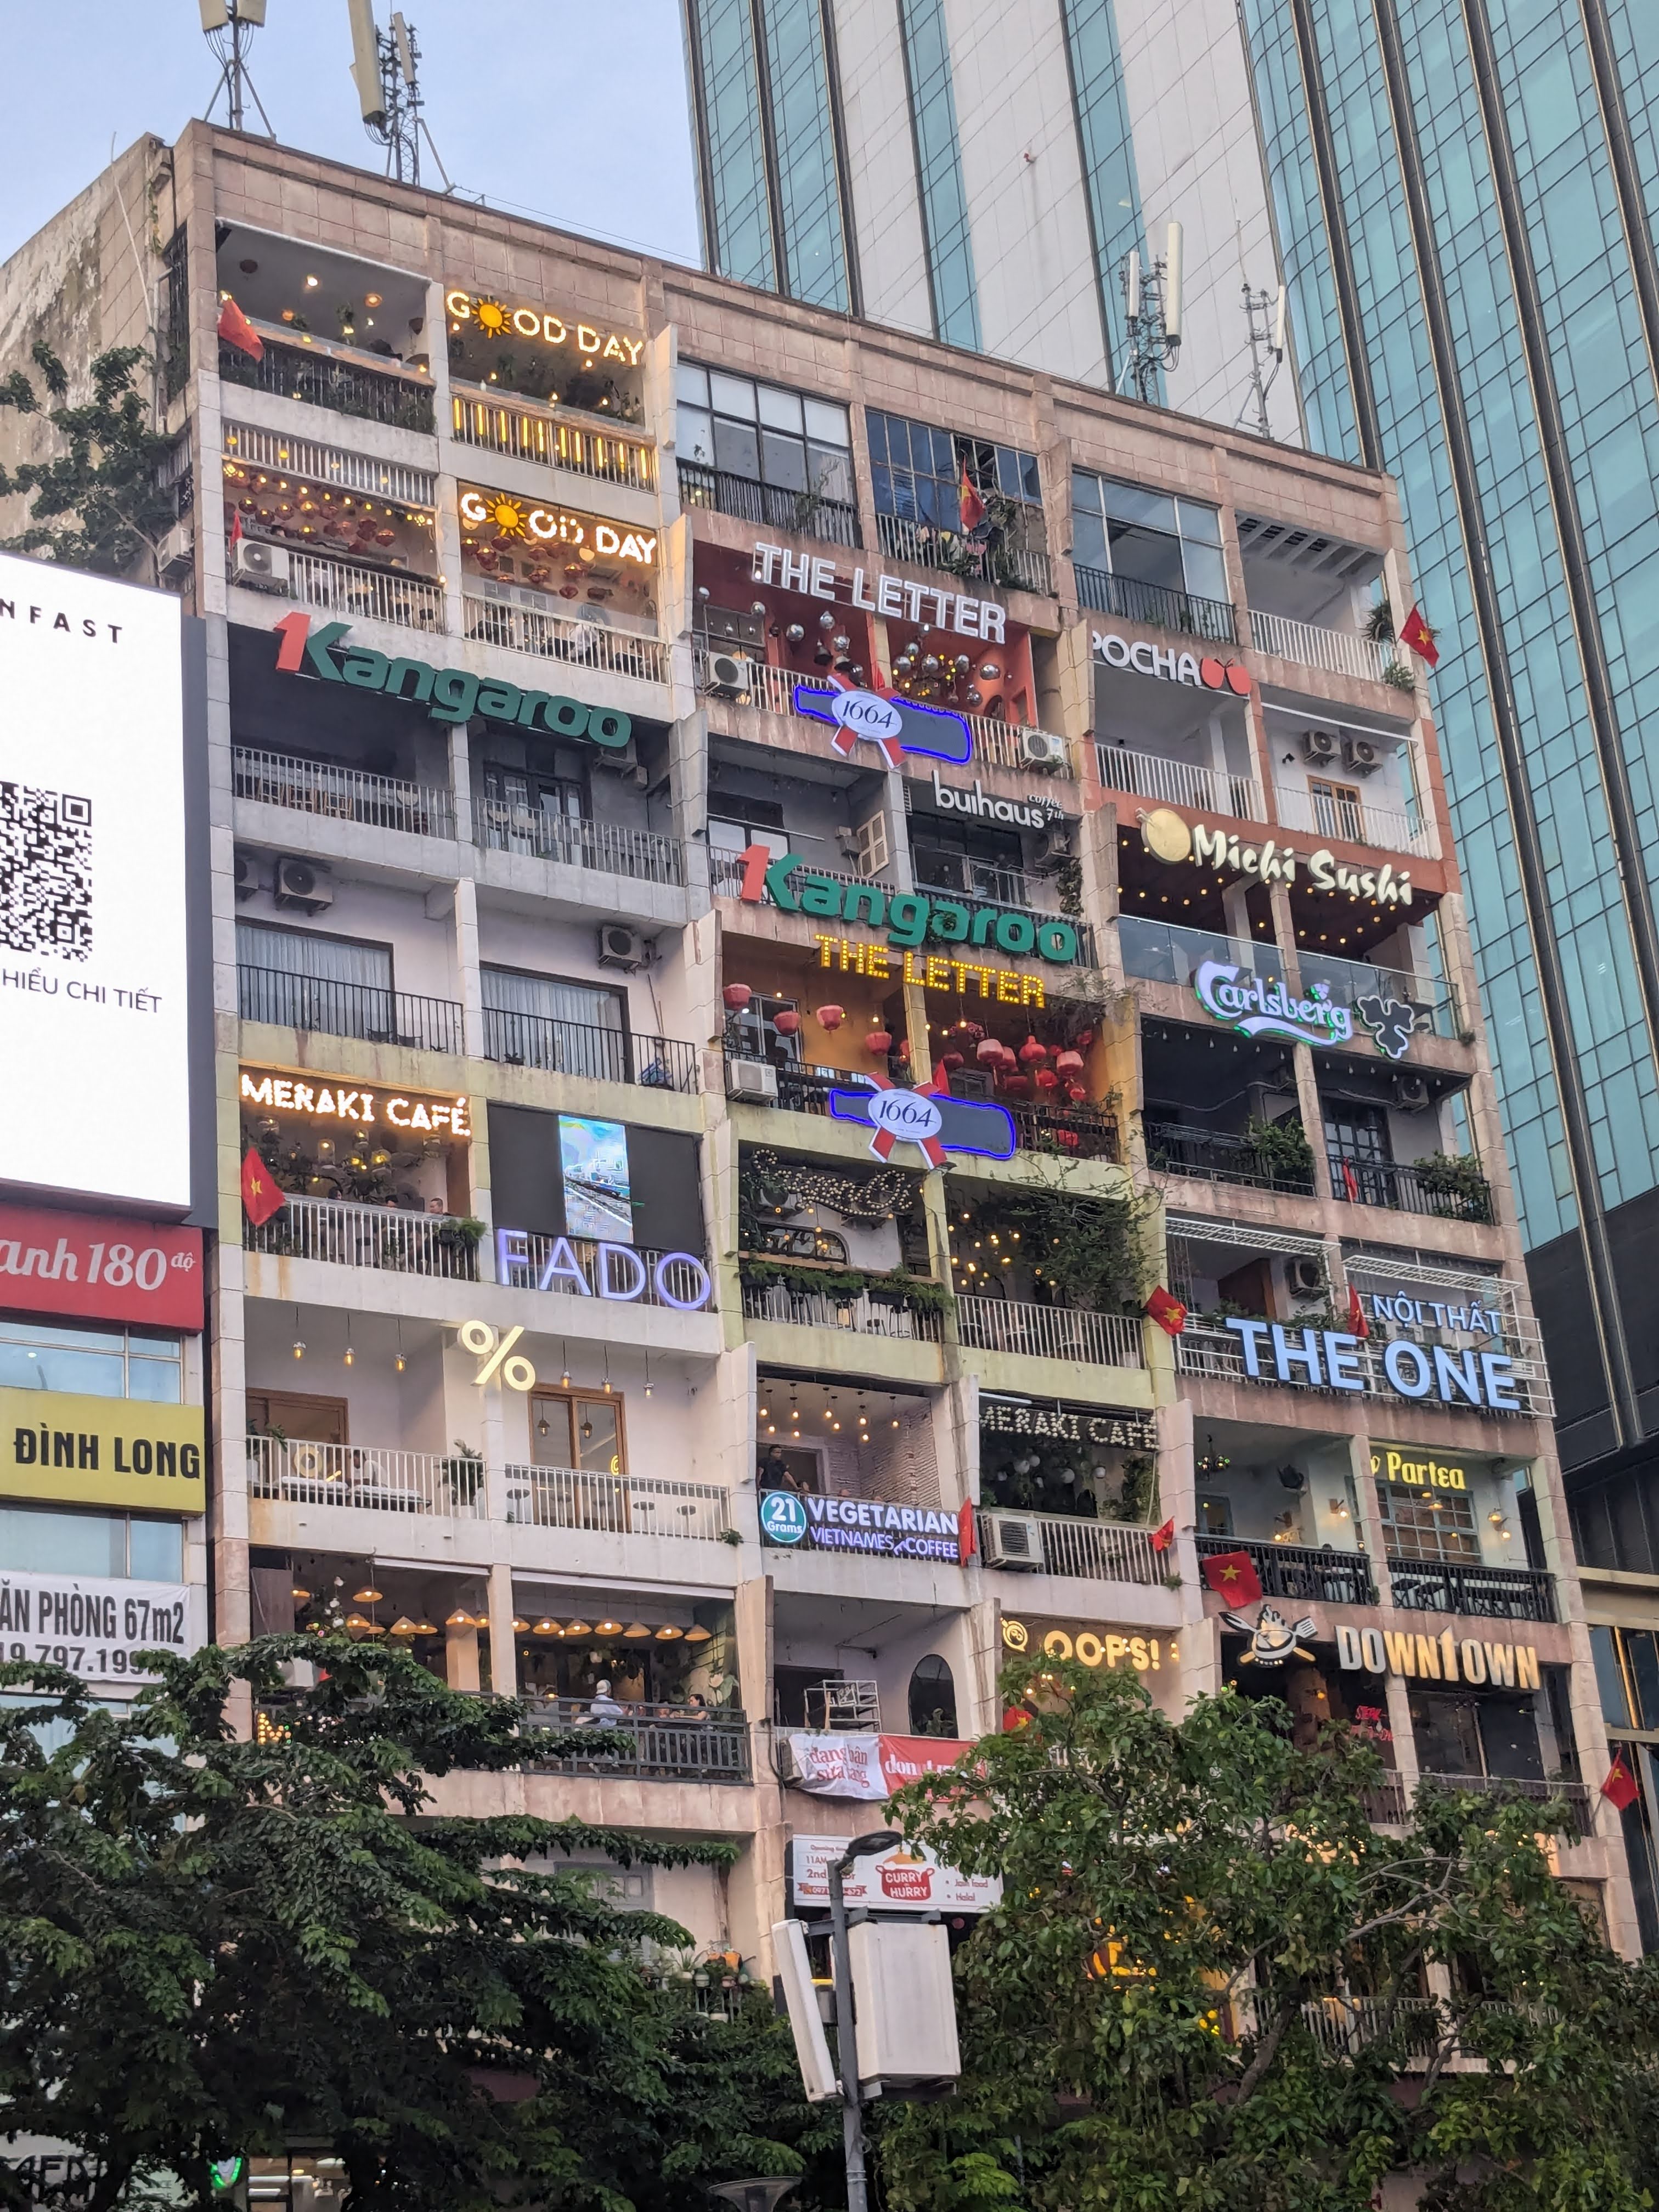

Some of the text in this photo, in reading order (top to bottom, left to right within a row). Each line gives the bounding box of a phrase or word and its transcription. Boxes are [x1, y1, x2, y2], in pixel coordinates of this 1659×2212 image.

[577, 324, 643, 365] DAY
[595, 525, 657, 565] DAY
[755, 541, 1006, 644] THE LETTER
[843, 700, 898, 729] 1664
[1029, 794, 1063, 809] coffee
[1046, 808, 1064, 821] 7th
[1192, 824, 1414, 906] Michi Sushi
[3, 967, 162, 1013] HIỂU CHI TIẾT
[814, 934, 1046, 1009] THE LETTER
[1195, 960, 1353, 1042] Carlsberg
[241, 1074, 471, 1137] MERAKI CAFÉ
[879, 1099, 937, 1127] 1664
[87, 1243, 167, 1291] 180
[171, 1250, 195, 1273] độ
[496, 1228, 711, 1311] FADO
[1372, 1290, 1502, 1337] NỘI THẤT
[1226, 1317, 1523, 1411] THE ONE
[14, 1421, 200, 1480] ĐÌNH LONG
[768, 1519, 803, 1534] Grams
[770, 1497, 797, 1522] 21
[807, 1497, 959, 1536] VEGETARIAN
[906, 1537, 959, 1559] COFFEE
[39, 1583, 116, 1639] PHÒNG
[125, 1598, 184, 1644] 67m2
[1044, 1630, 1160, 1671] OOPS!
[806, 1869, 827, 1878] 2nd
[885, 1872, 923, 1884] CURRY
[890, 1886, 928, 1898] HURRY
